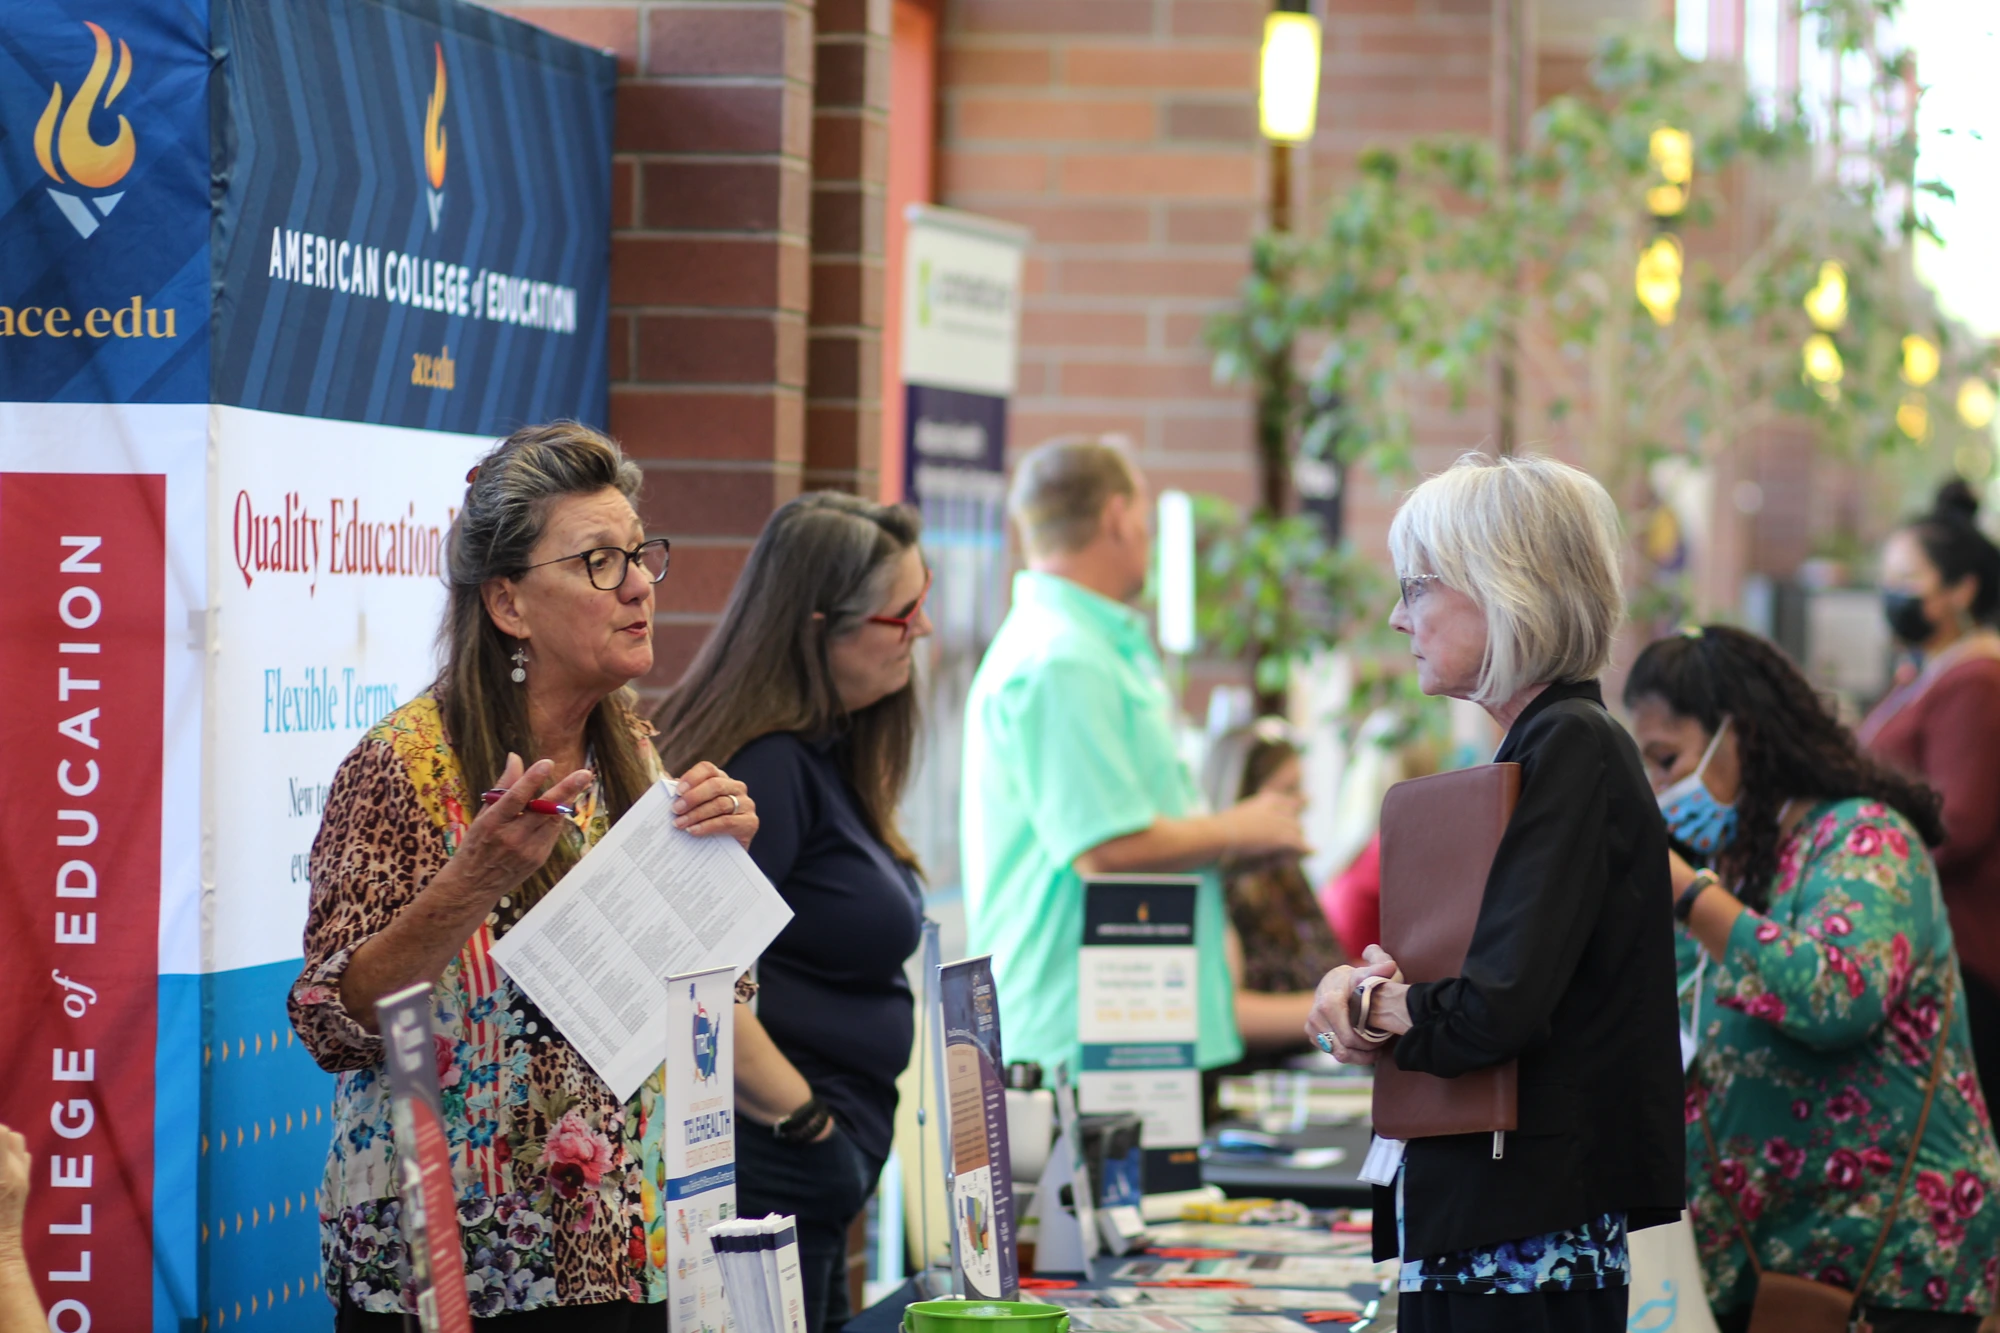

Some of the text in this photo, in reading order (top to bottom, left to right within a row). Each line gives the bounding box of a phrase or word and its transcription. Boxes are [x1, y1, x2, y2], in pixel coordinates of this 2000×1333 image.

[268, 226, 577, 334] AMERICAN COLLEGE of EDUCATION
[0, 295, 177, 339] ace.edu
[411, 345, 455, 391] ace.edu
[234, 490, 440, 599] Quality Education
[263, 667, 398, 734] Flexible Terms
[55, 535, 102, 945] EDUCATION
[288, 777, 313, 818] New
[51, 968, 97, 1019] of
[683, 1109, 731, 1147] TELEHEALTH
